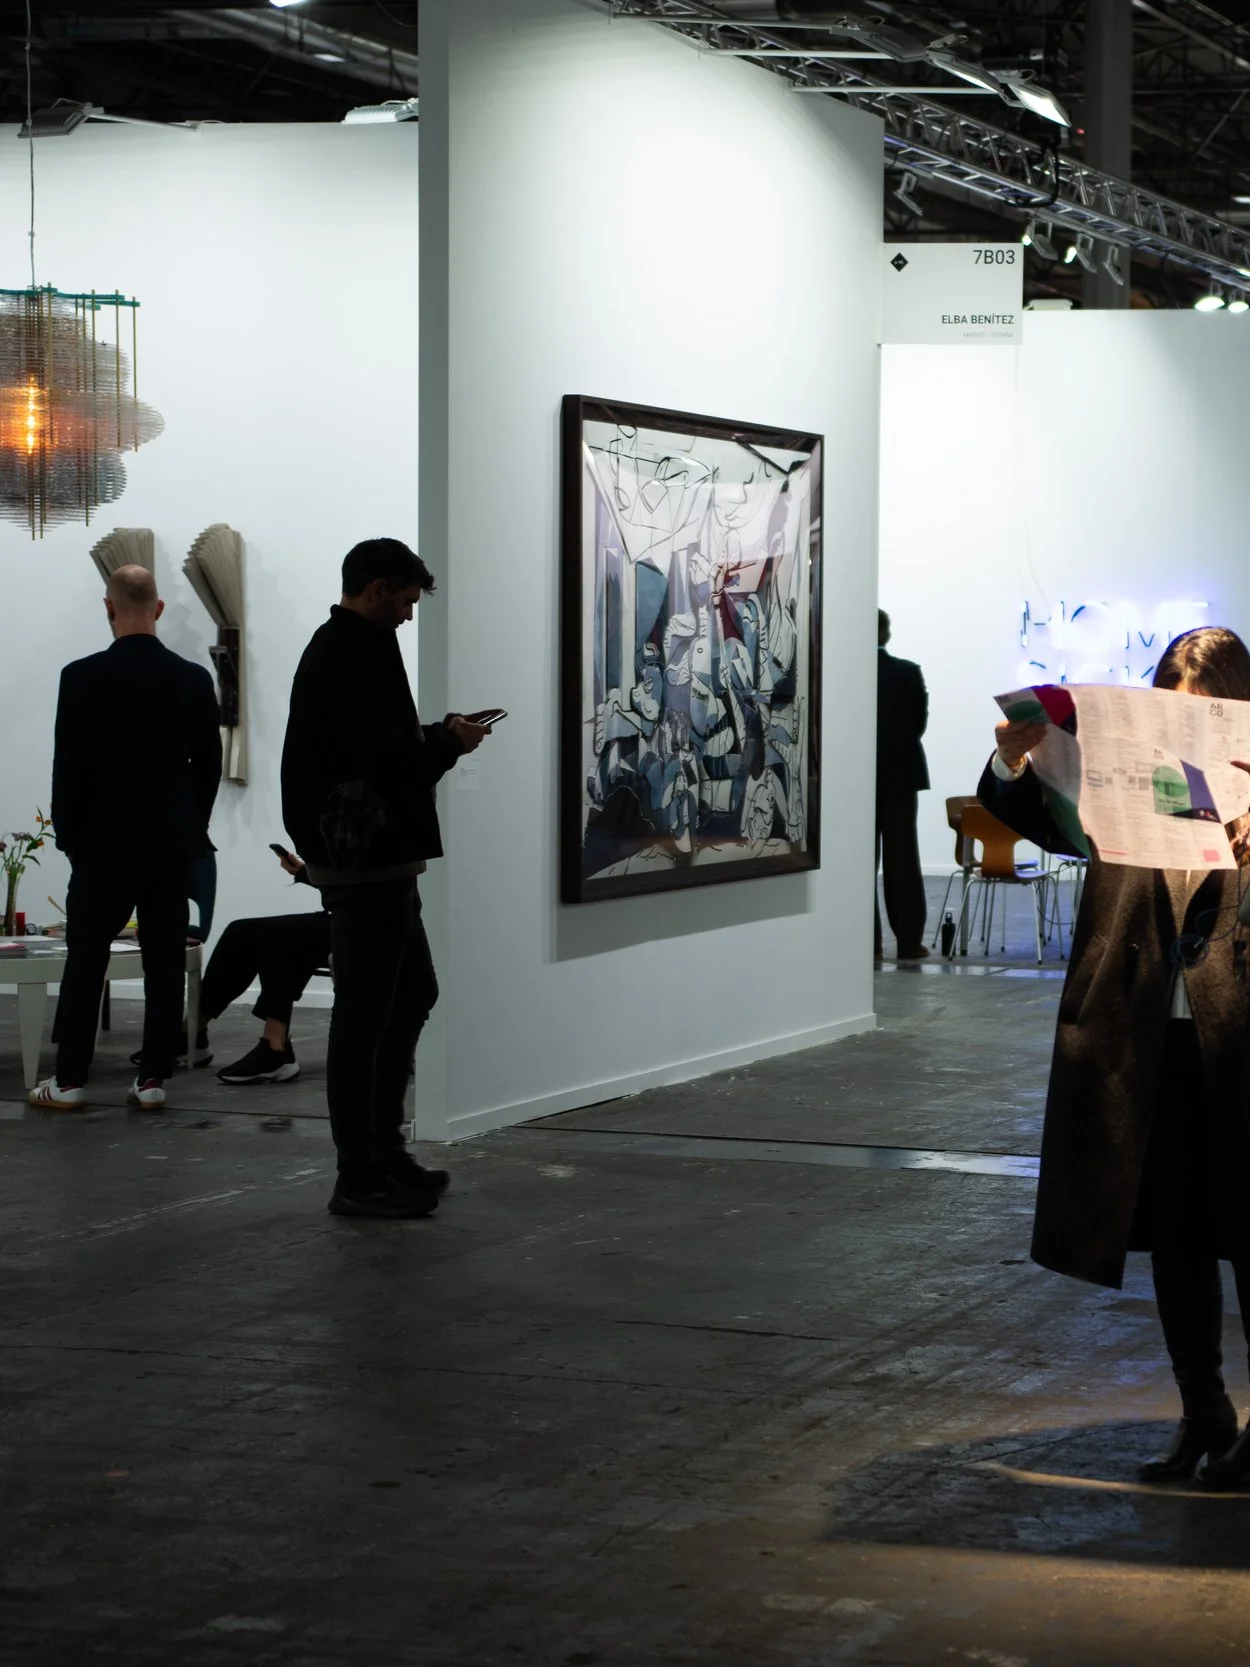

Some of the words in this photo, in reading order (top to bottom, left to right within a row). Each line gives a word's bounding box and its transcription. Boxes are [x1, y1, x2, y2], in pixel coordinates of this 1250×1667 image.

[972, 249, 1016, 265] 7B03
[941, 314, 968, 325] ELBA
[970, 312, 1015, 325] BENÍTEZ
